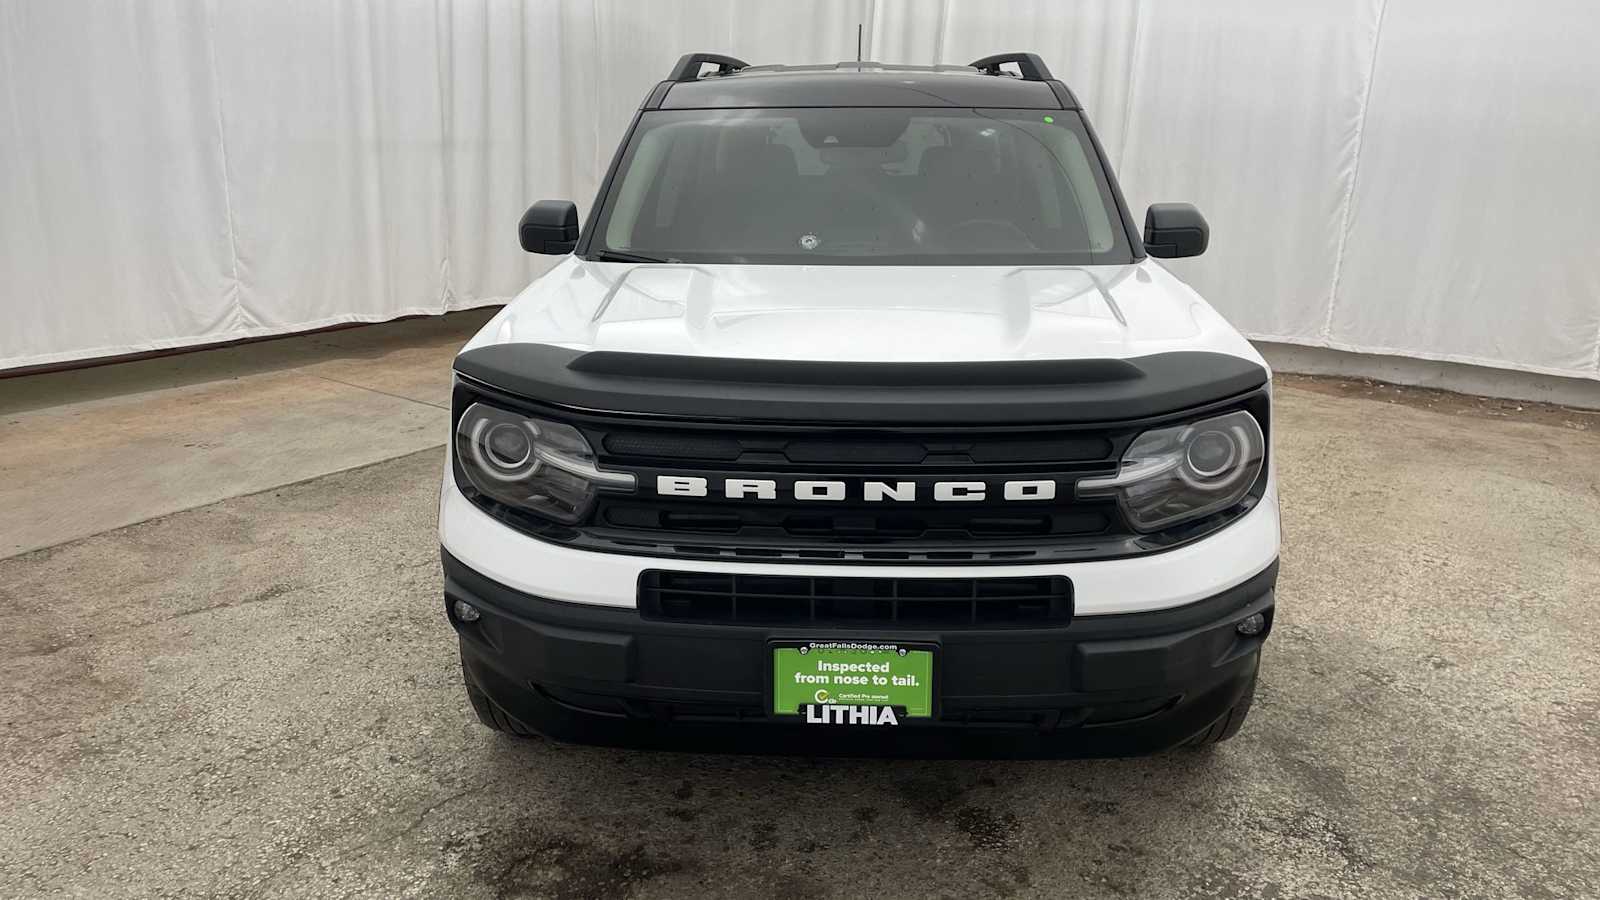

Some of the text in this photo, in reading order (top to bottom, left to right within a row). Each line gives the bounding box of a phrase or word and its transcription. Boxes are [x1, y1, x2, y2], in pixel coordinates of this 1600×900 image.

[656, 475, 1056, 502] BRONCO
[817, 660, 890, 674] Inspected
[794, 672, 920, 687] from nose to tail.
[806, 704, 898, 726] LITHIA
